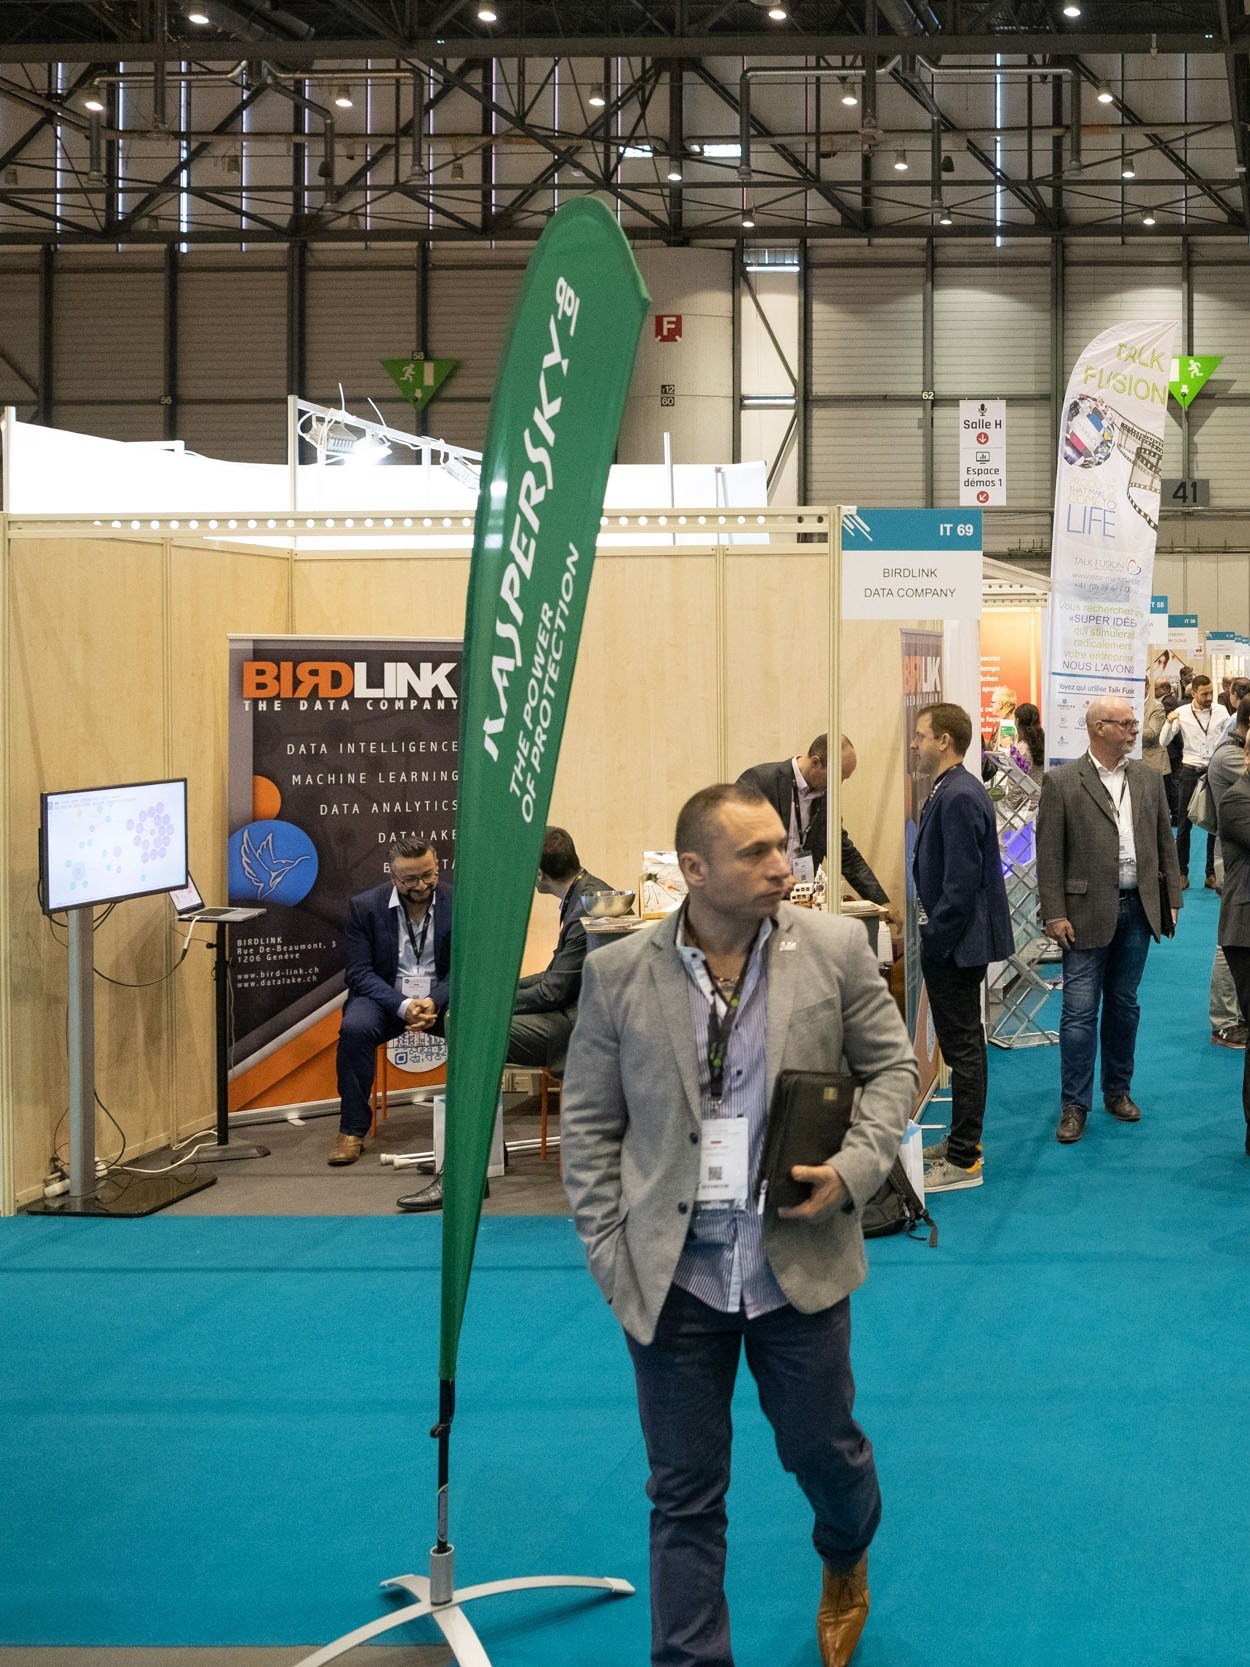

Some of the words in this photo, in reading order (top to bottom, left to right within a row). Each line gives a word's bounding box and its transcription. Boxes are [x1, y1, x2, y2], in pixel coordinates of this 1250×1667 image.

[663, 316, 677, 336] F
[1116, 343, 1166, 372] TALK
[1083, 365, 1167, 405] FUSION
[661, 397, 675, 406] 60
[922, 390, 935, 400] 62
[963, 419, 992, 430] Salle
[994, 419, 1003, 429] H
[966, 467, 1000, 477] Espace
[964, 477, 996, 487] démos
[997, 478, 1003, 487] 1
[1172, 481, 1198, 503] 41
[1066, 503, 1117, 539] LIFE
[939, 523, 953, 536] IT
[956, 523, 974, 537] 69
[483, 314, 569, 762] KASPERSKY
[882, 567, 939, 579] BIRDLINK
[864, 588, 894, 598] DATA
[897, 588, 956, 598] COMPANY
[1062, 660, 1092, 671] NOUS
[242, 660, 459, 699] BIRDLINK
[521, 775, 539, 824] OF
[530, 542, 580, 778] PROTECTION
[243, 700, 283, 712] THE
[299, 700, 350, 711] DATA
[366, 699, 459, 711] COMPANY
[508, 732, 532, 799] THE
[523, 602, 554, 730] POWER
[286, 742, 328, 756] DATA
[339, 741, 459, 754] INTELLIGENCE
[292, 772, 367, 786] MACHINE
[378, 770, 459, 784] LEARNING
[320, 803, 361, 816] DATA
[371, 799, 459, 814] ANALYTICS
[236, 936, 283, 947] BIRDLINK
[237, 947, 254, 955] Rue
[331, 940, 337, 948] 3
[237, 954, 261, 963] 1206
[266, 952, 301, 961] Genève
[236, 966, 320, 980] www.bird-link.ch
[236, 975, 318, 988] www.datalake.ch
